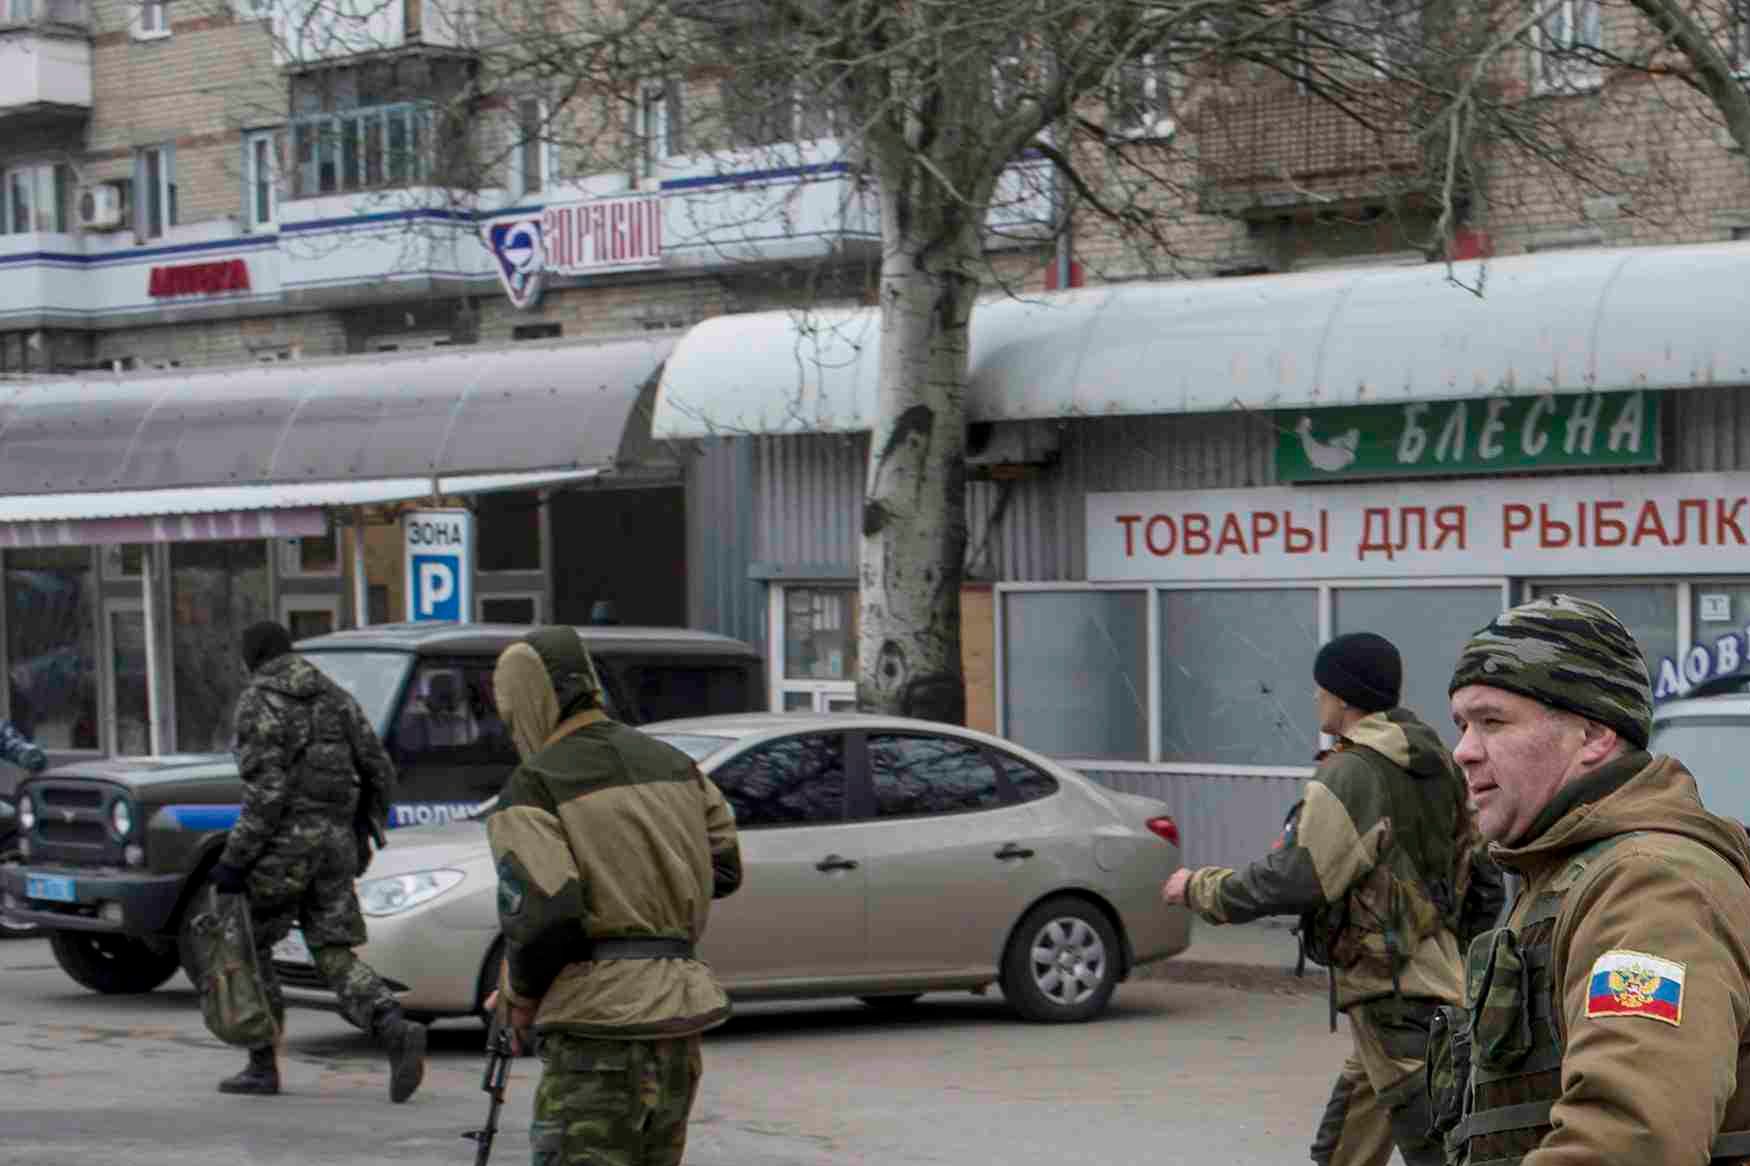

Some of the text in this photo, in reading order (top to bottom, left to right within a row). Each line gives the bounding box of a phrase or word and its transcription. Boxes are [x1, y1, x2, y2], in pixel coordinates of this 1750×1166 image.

[1396, 386, 1645, 464] БЛЕСНА
[407, 521, 462, 546] ЗОНА
[1115, 509, 1329, 557] ТОВАРЫ
[1357, 504, 1467, 562] ДЛЯ
[420, 562, 454, 616] P
